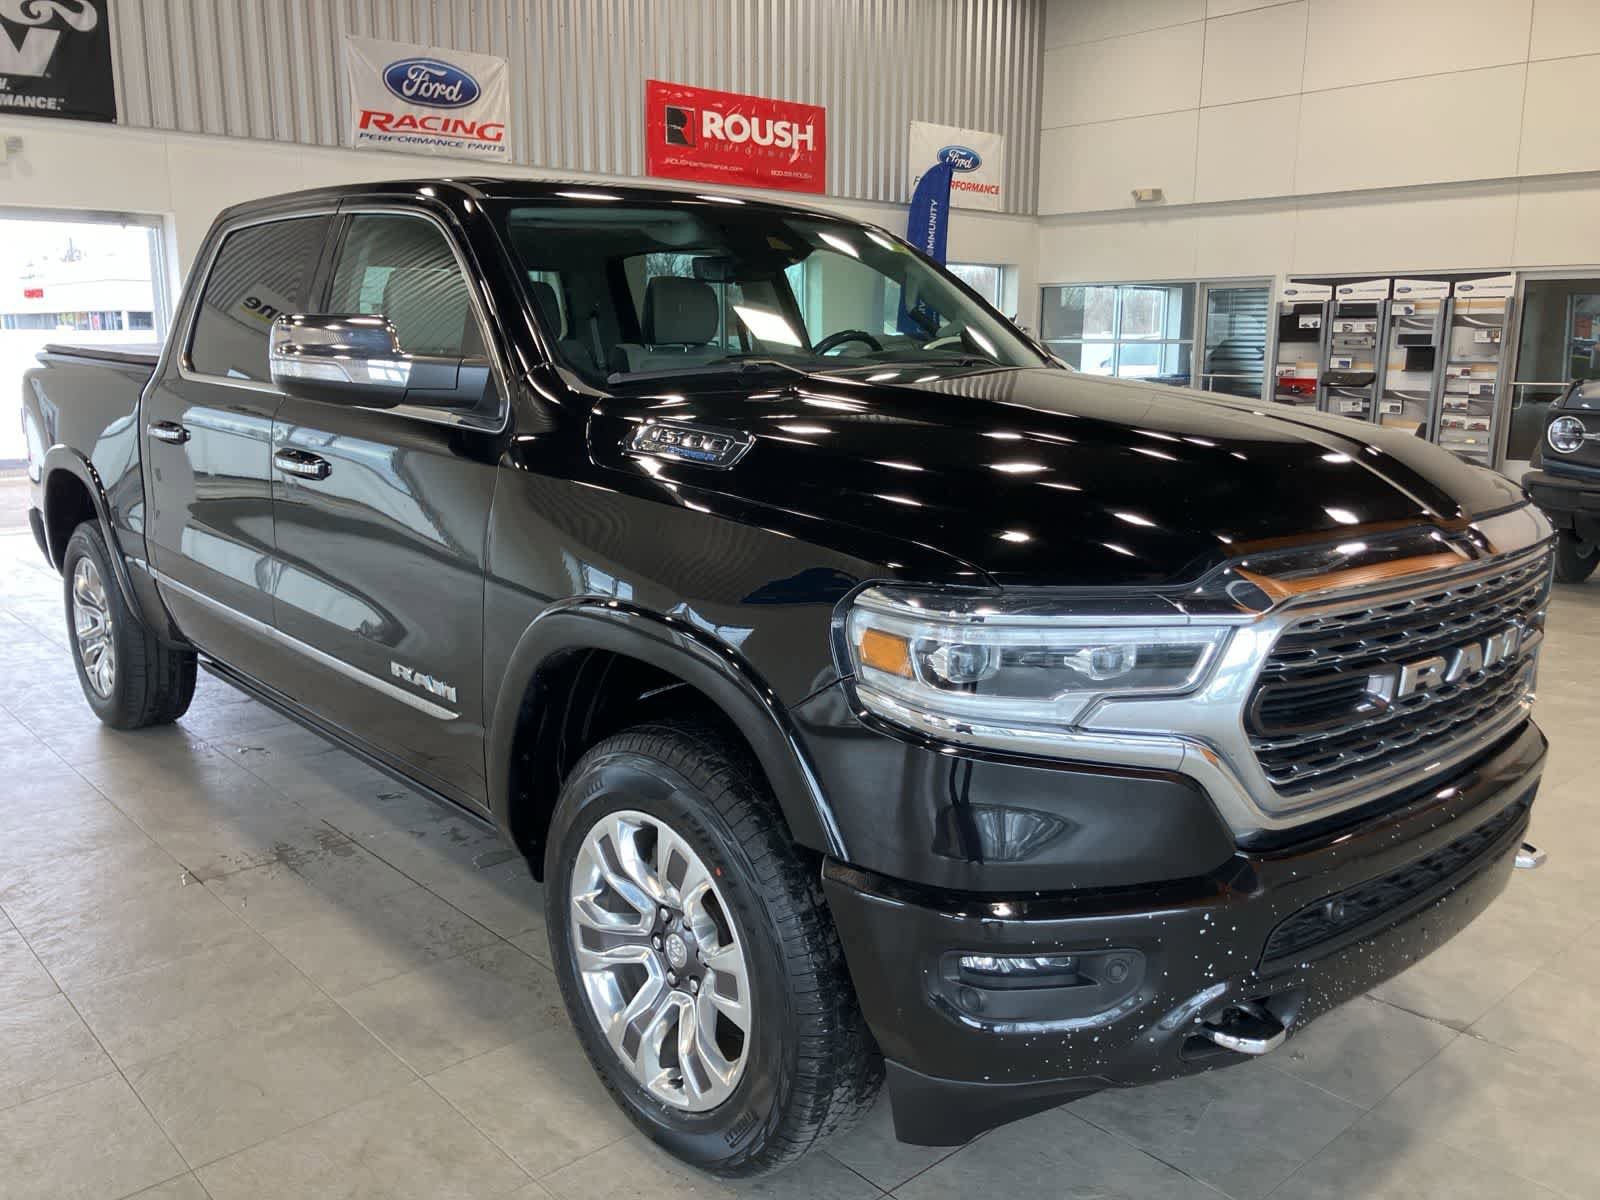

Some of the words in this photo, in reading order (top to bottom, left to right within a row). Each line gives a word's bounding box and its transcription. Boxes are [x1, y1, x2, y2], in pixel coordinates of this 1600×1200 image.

[402, 64, 462, 102] Ford
[0, 93, 61, 110] MANCE.
[359, 110, 505, 142] RACING
[359, 132, 464, 149] PERFORMANCE
[467, 143, 505, 152] PARTS
[702, 110, 814, 151] ROUSH
[945, 150, 974, 169] Ford
[950, 180, 1000, 195] RFORMANCE
[926, 199, 938, 257] OMMUNITY
[1396, 626, 1522, 698] RAM
[390, 660, 457, 703] RAM
